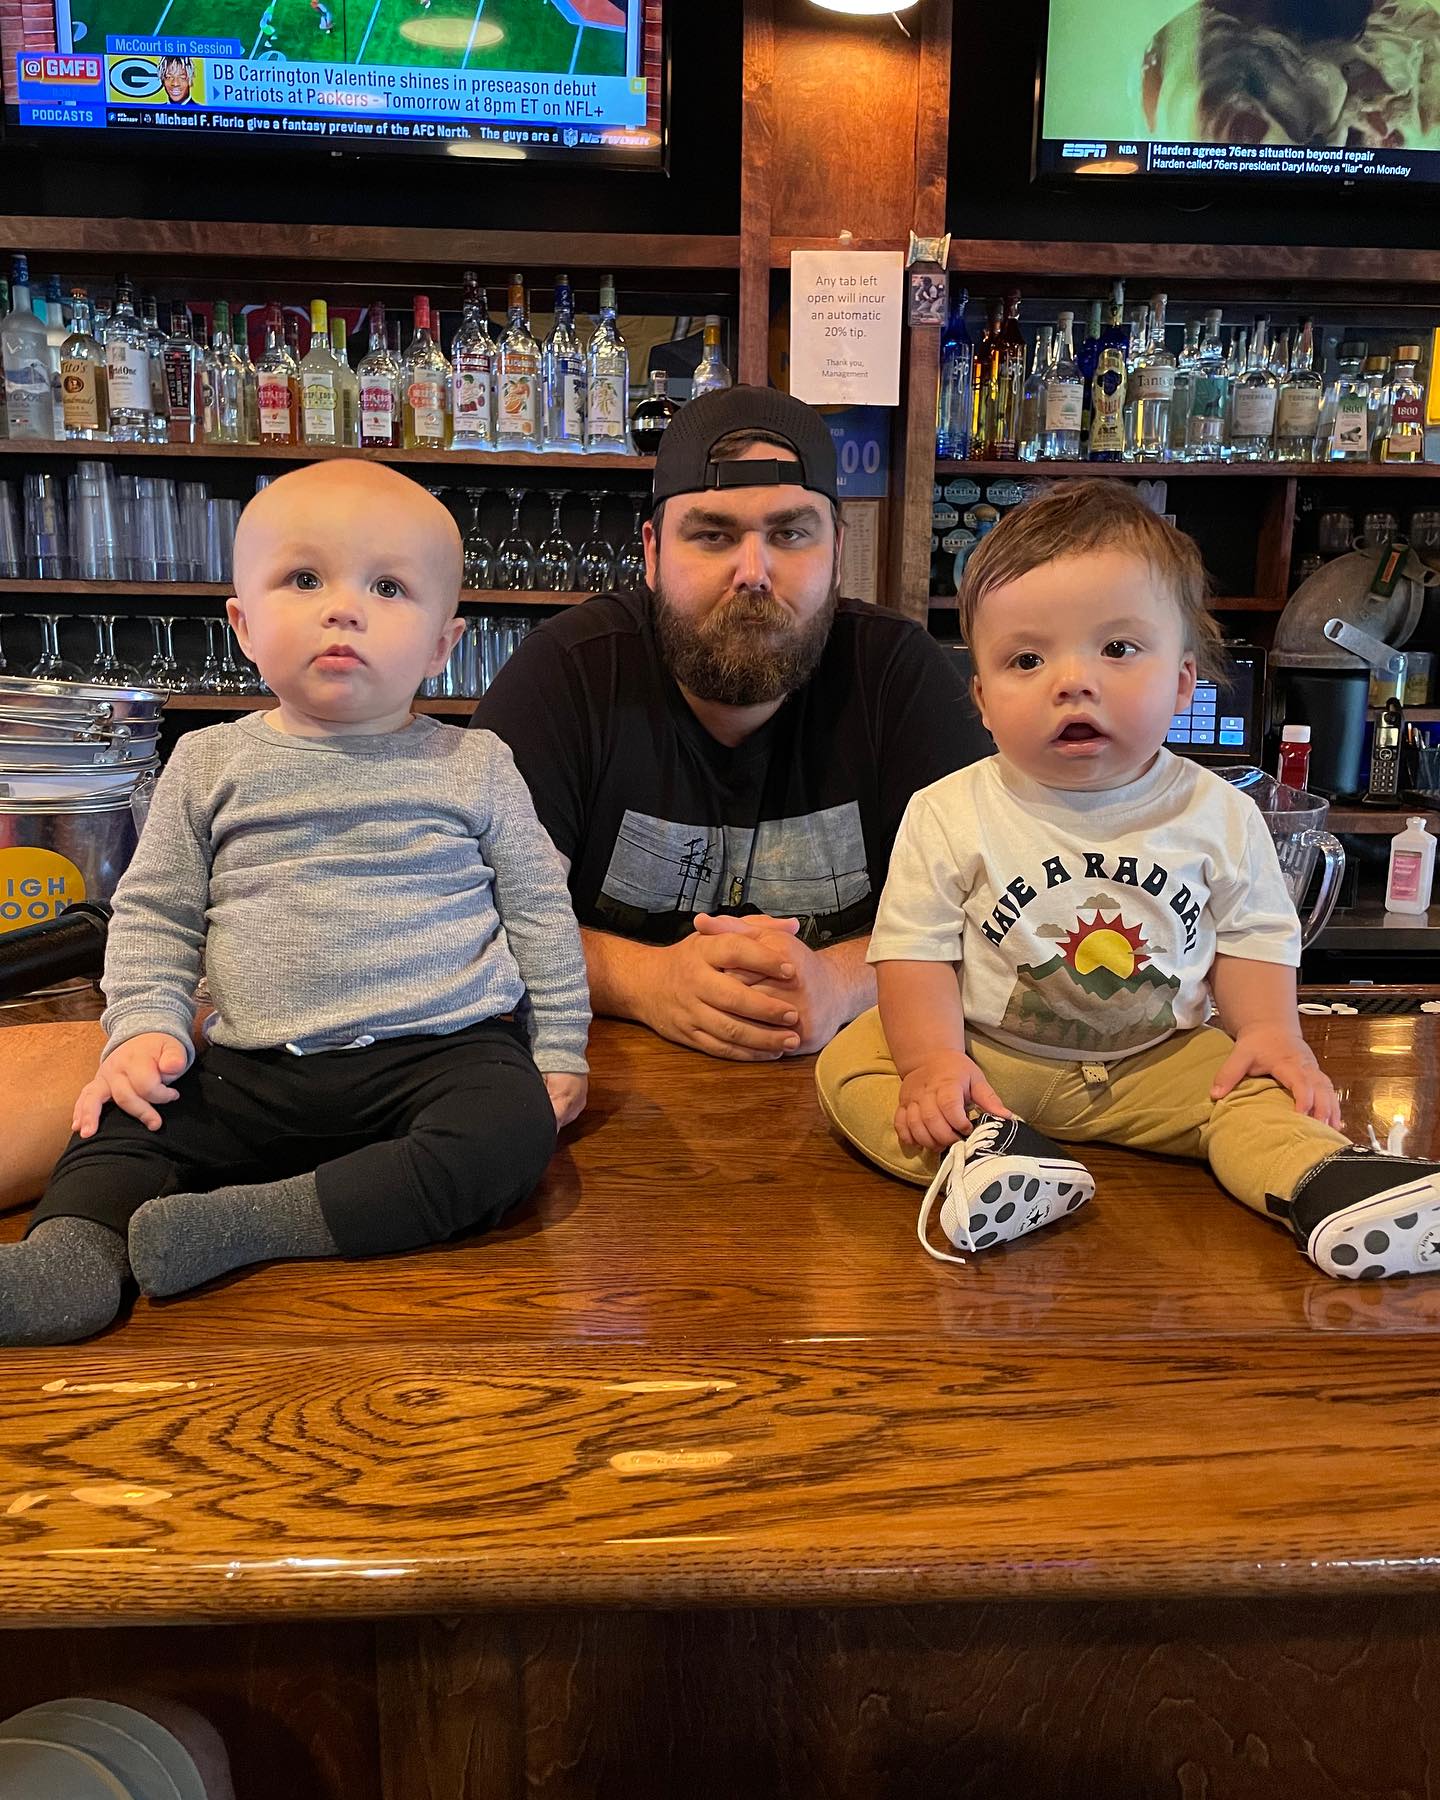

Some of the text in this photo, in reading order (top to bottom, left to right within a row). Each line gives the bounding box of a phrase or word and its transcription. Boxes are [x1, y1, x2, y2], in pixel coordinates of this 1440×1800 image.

[116, 39, 233, 55] McCourt is in Session
[46, 60, 98, 76] GMFB
[213, 64, 597, 97] DB Carrington Valentine shines in preseason debut
[224, 85, 284, 103] Patriots
[288, 89, 303, 104] at
[307, 89, 368, 107] Packers
[384, 92, 460, 112] Tomorrow
[465, 96, 480, 112] at
[483, 96, 516, 117] 8pm
[520, 98, 539, 115] ET
[543, 103, 561, 116] on
[565, 101, 604, 118] NFL+
[32, 109, 93, 122] PODCASTS
[155, 113, 559, 144] Michael F. Florio give a fantasy preview of the AFC North. The guys are a
[1062, 143, 1107, 157] ESPN
[1118, 145, 1138, 155] NBA
[1153, 144, 1375, 162] Harden agrees 76ers situation beyond repair
[1153, 158, 1185, 169] Harden
[1186, 159, 1212, 169] called
[1213, 159, 1238, 170] 76ers
[1239, 161, 1280, 172] president
[1281, 162, 1305, 174] Daryl
[1306, 163, 1333, 175] Morey
[1364, 166, 1375, 174] on
[1376, 165, 1411, 177] Monday
[815, 276, 878, 288] Any tab left
[807, 293, 886, 304] open will incur
[811, 311, 881, 321] an automatic
[824, 327, 867, 339] 20% tip.
[826, 359, 847, 367] Thank
[821, 370, 869, 379] Management
[1397, 406, 1419, 416] 1800
[7, 876, 65, 897] IGH
[981, 876, 1038, 948] HAVE
[1042, 856, 1072, 889] A
[1082, 853, 1168, 896] RAD
[0, 898, 73, 920] OON
